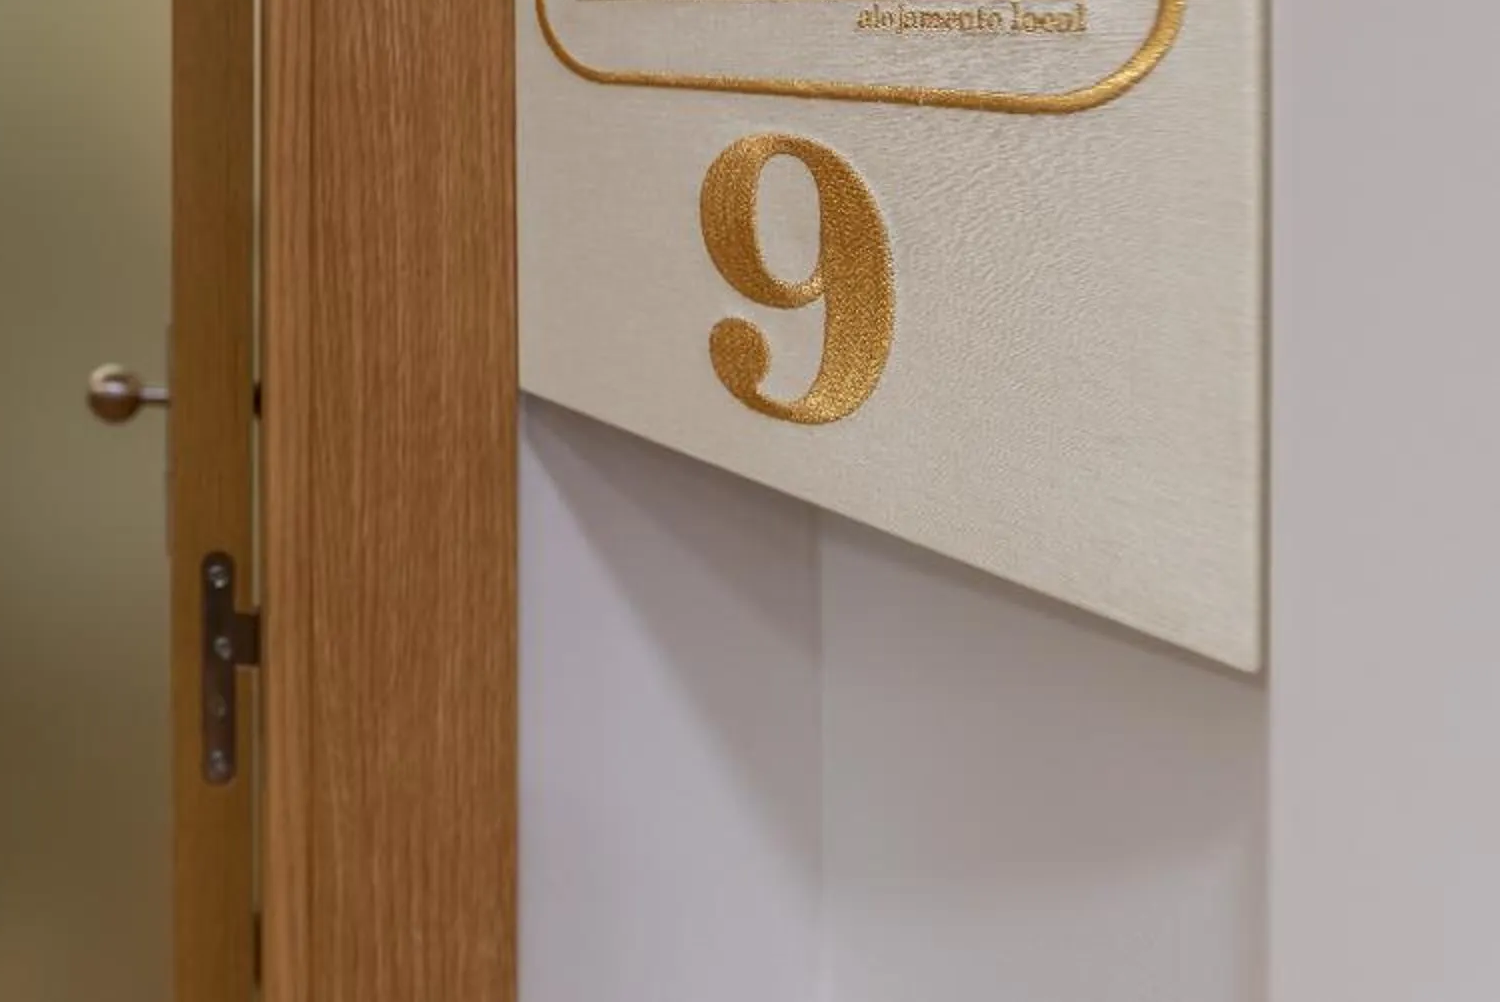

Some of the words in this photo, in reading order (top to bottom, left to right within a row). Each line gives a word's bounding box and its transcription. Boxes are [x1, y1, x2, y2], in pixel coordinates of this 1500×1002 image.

[856, 2, 1002, 35] alojamento
[1009, 0, 1088, 33] local
[699, 132, 896, 425] 9
